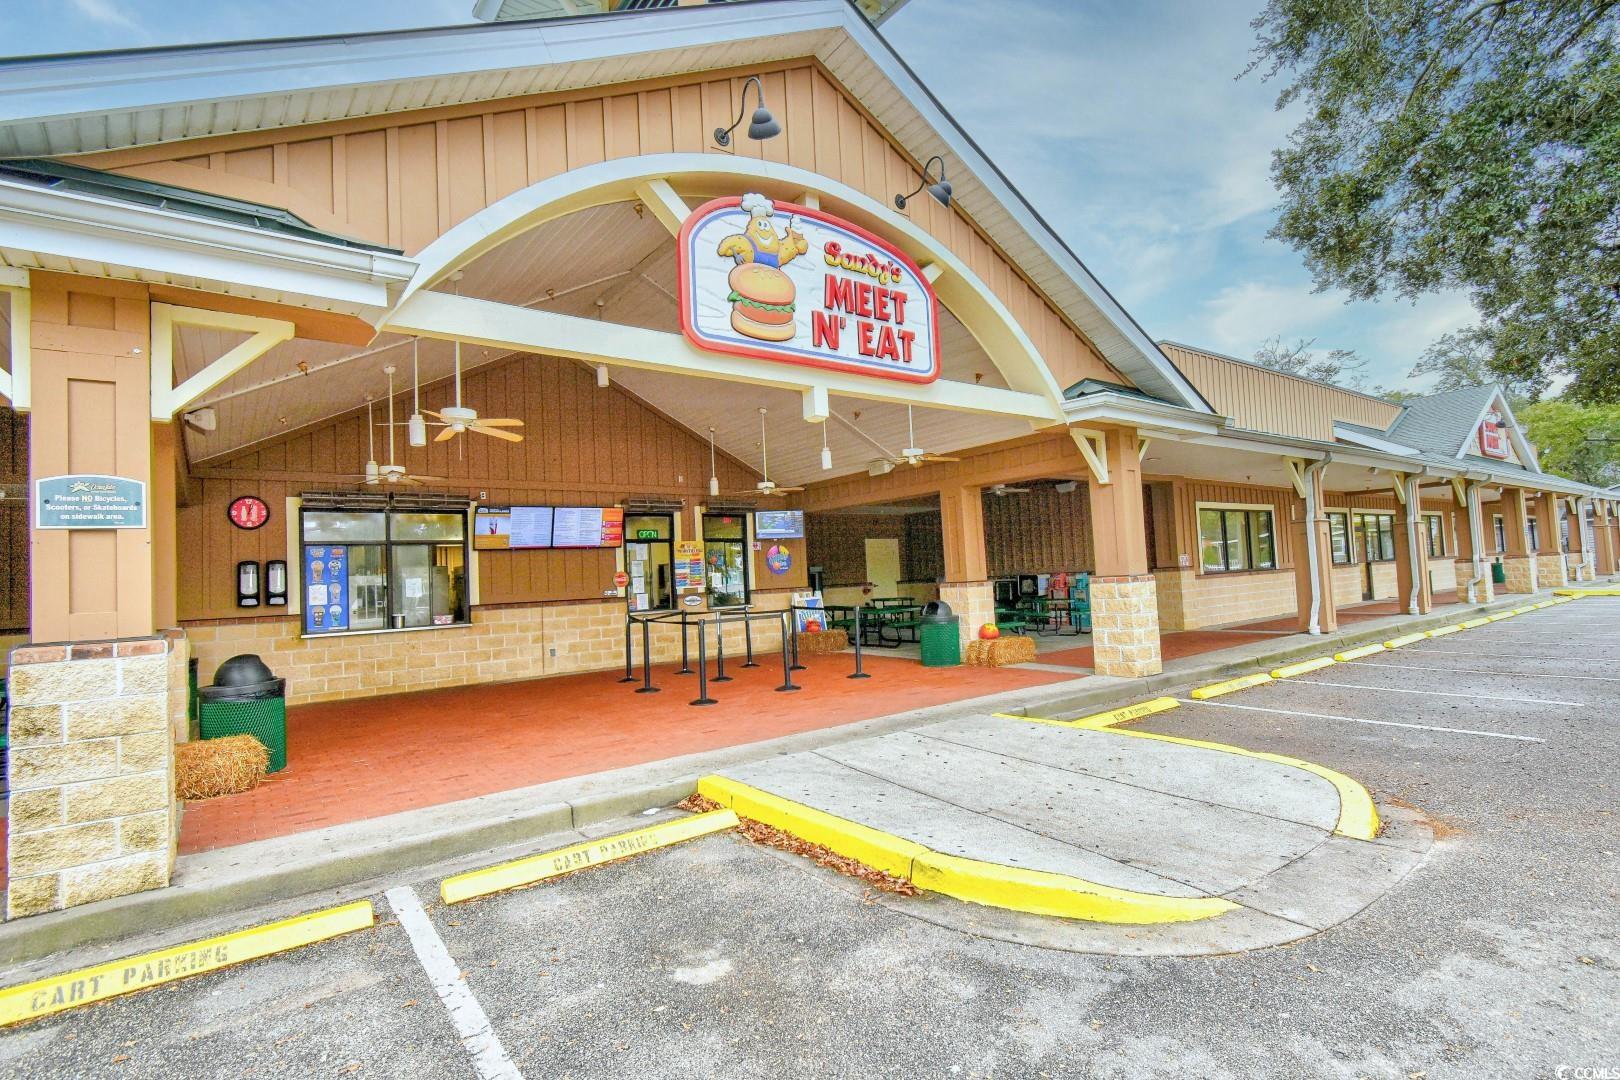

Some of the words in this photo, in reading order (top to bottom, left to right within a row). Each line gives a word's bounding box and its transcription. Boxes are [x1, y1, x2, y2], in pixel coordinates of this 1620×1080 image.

[824, 241, 902, 285] Sandy's
[825, 273, 908, 325] MEET
[812, 310, 846, 350] N'
[857, 320, 915, 363] EAT
[46, 503, 82, 511] Scooters,
[95, 495, 128, 503] Bicycles,
[553, 850, 590, 871] CART
[600, 834, 658, 853] PARKIN
[32, 975, 104, 1011] CART
[122, 945, 228, 984] PARKING
